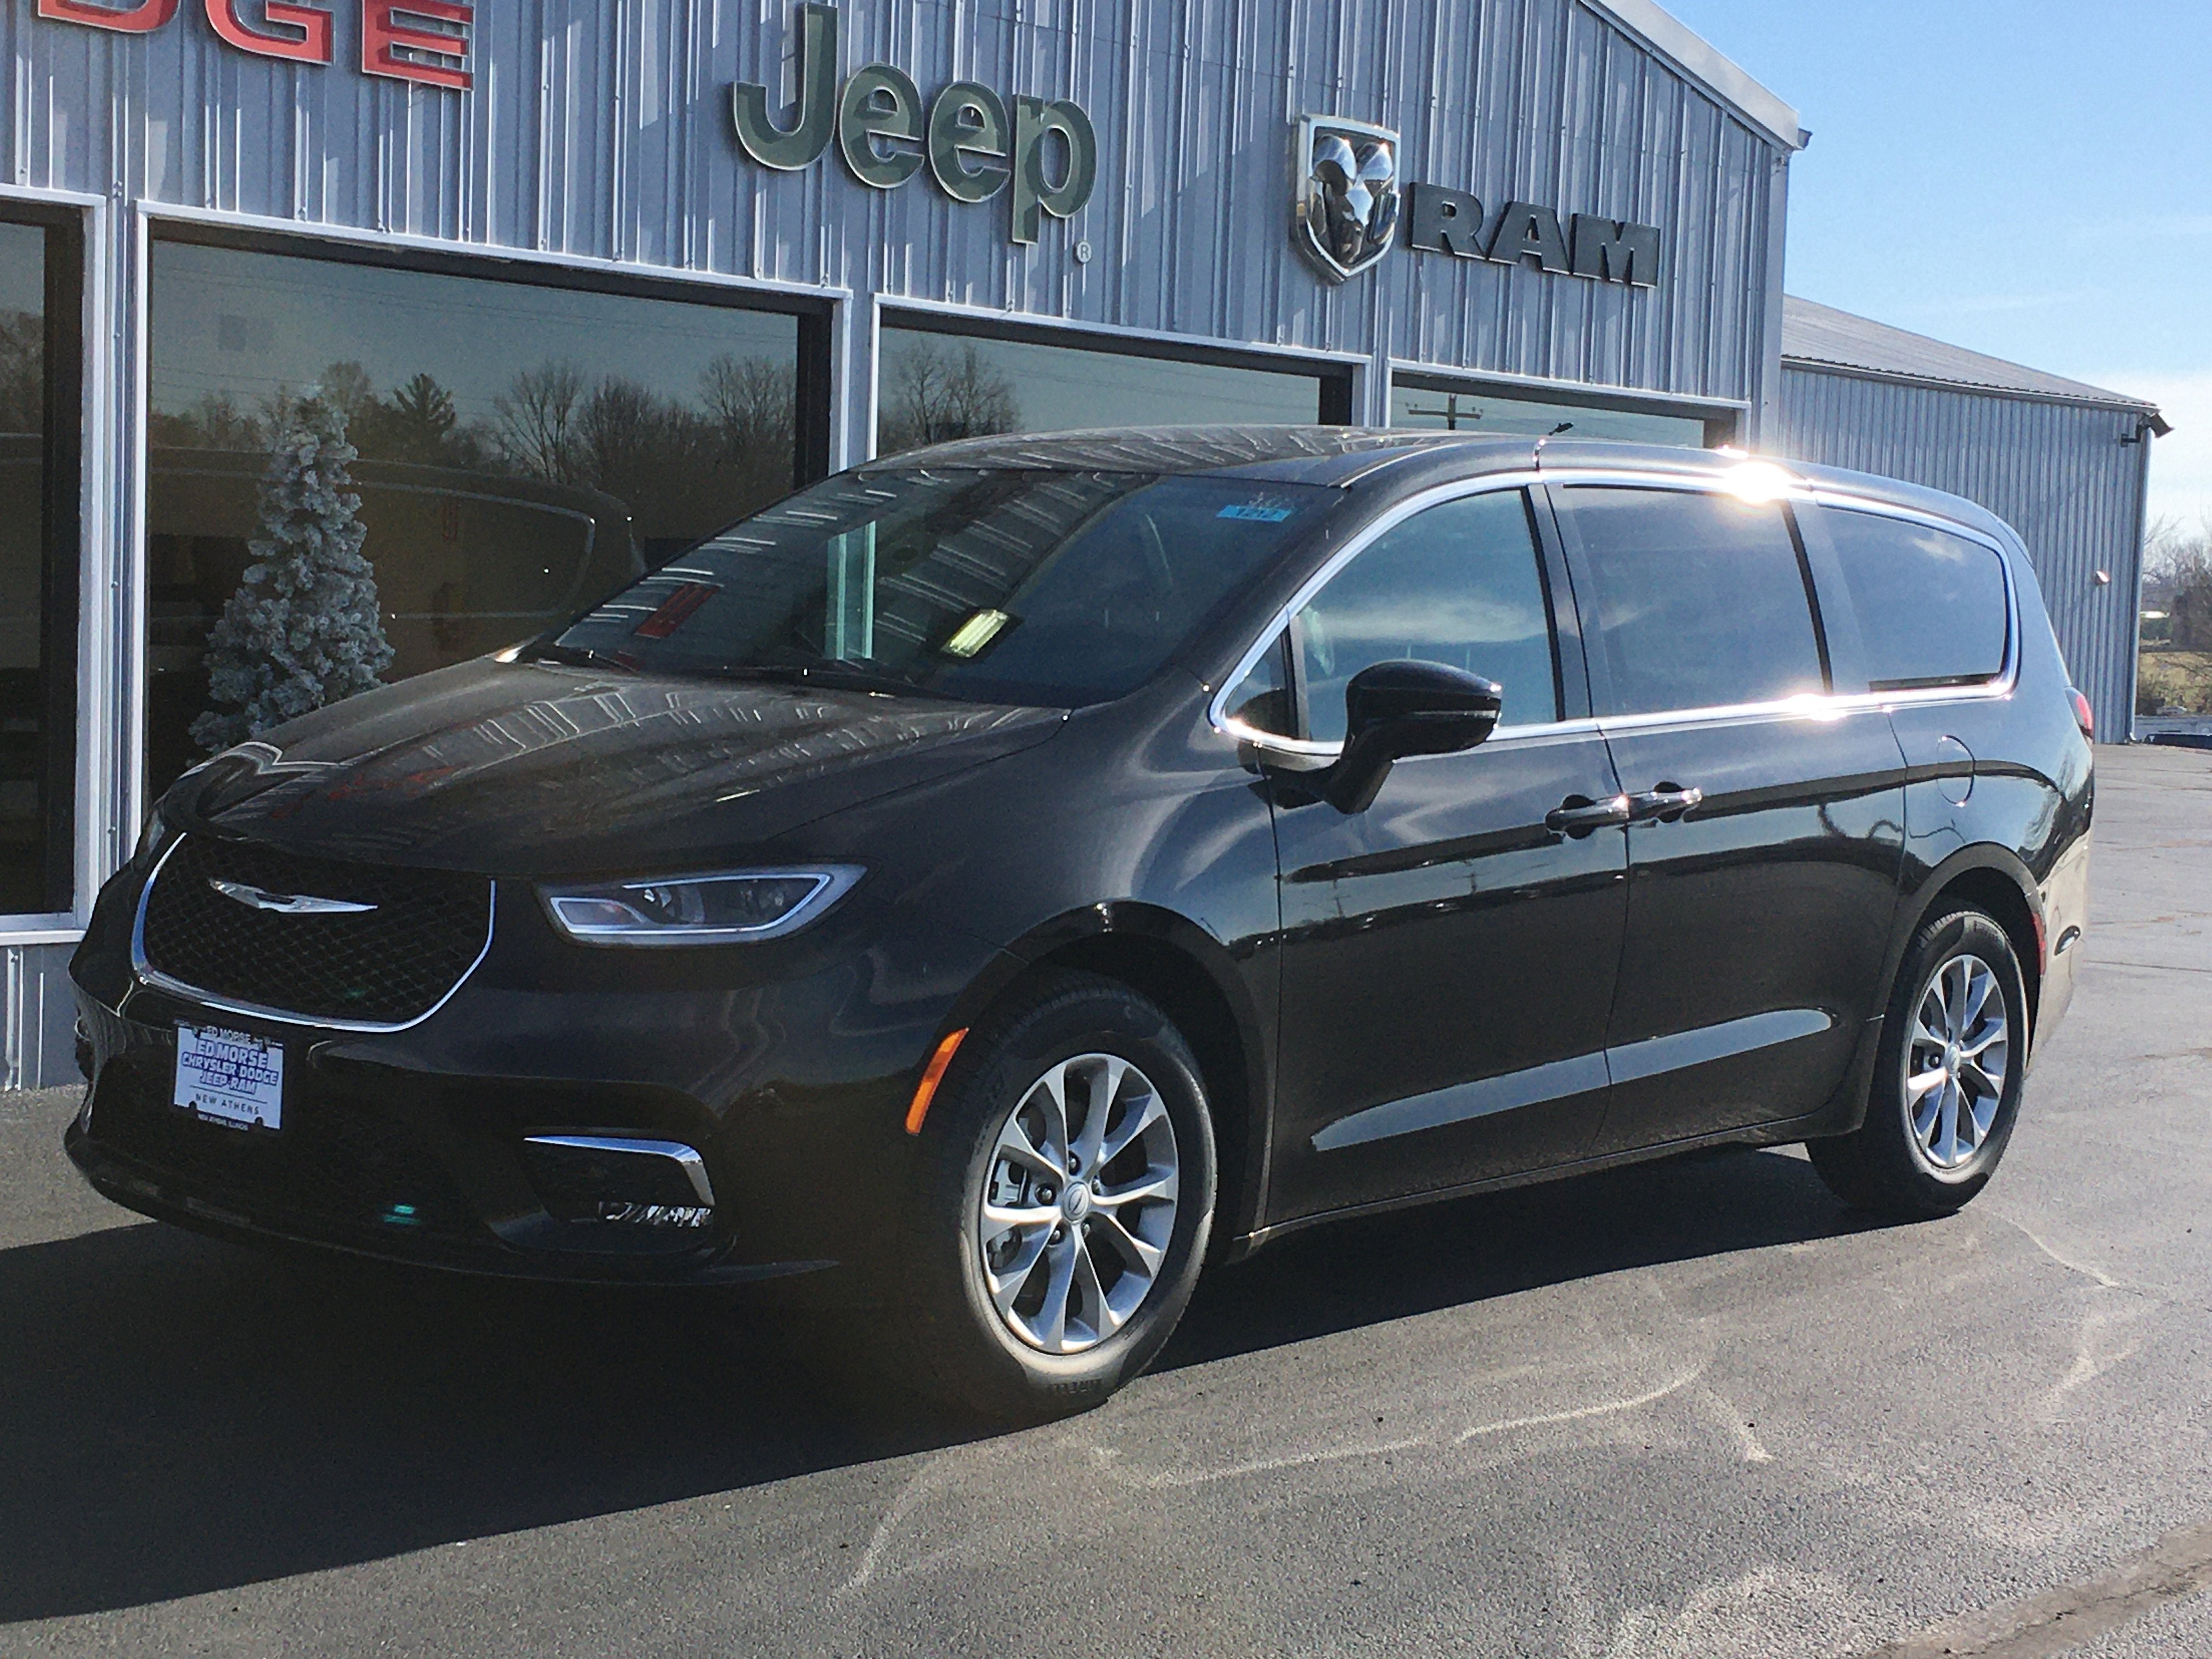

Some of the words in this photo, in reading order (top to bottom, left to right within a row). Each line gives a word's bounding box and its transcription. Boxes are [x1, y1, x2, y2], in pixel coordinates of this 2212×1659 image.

[732, 2, 1097, 245] Jeep
[1408, 181, 1661, 289] RAM
[182, 1052, 237, 1076] CHRYSLER
[239, 1065, 278, 1084] DODGE
[197, 1039, 215, 1057] ED
[216, 1043, 268, 1069] MORSE
[200, 1071, 228, 1086] JEEP
[229, 1077, 257, 1094] RAM
[195, 1093, 217, 1104] NEW
[221, 1099, 259, 1115] ATHENS
